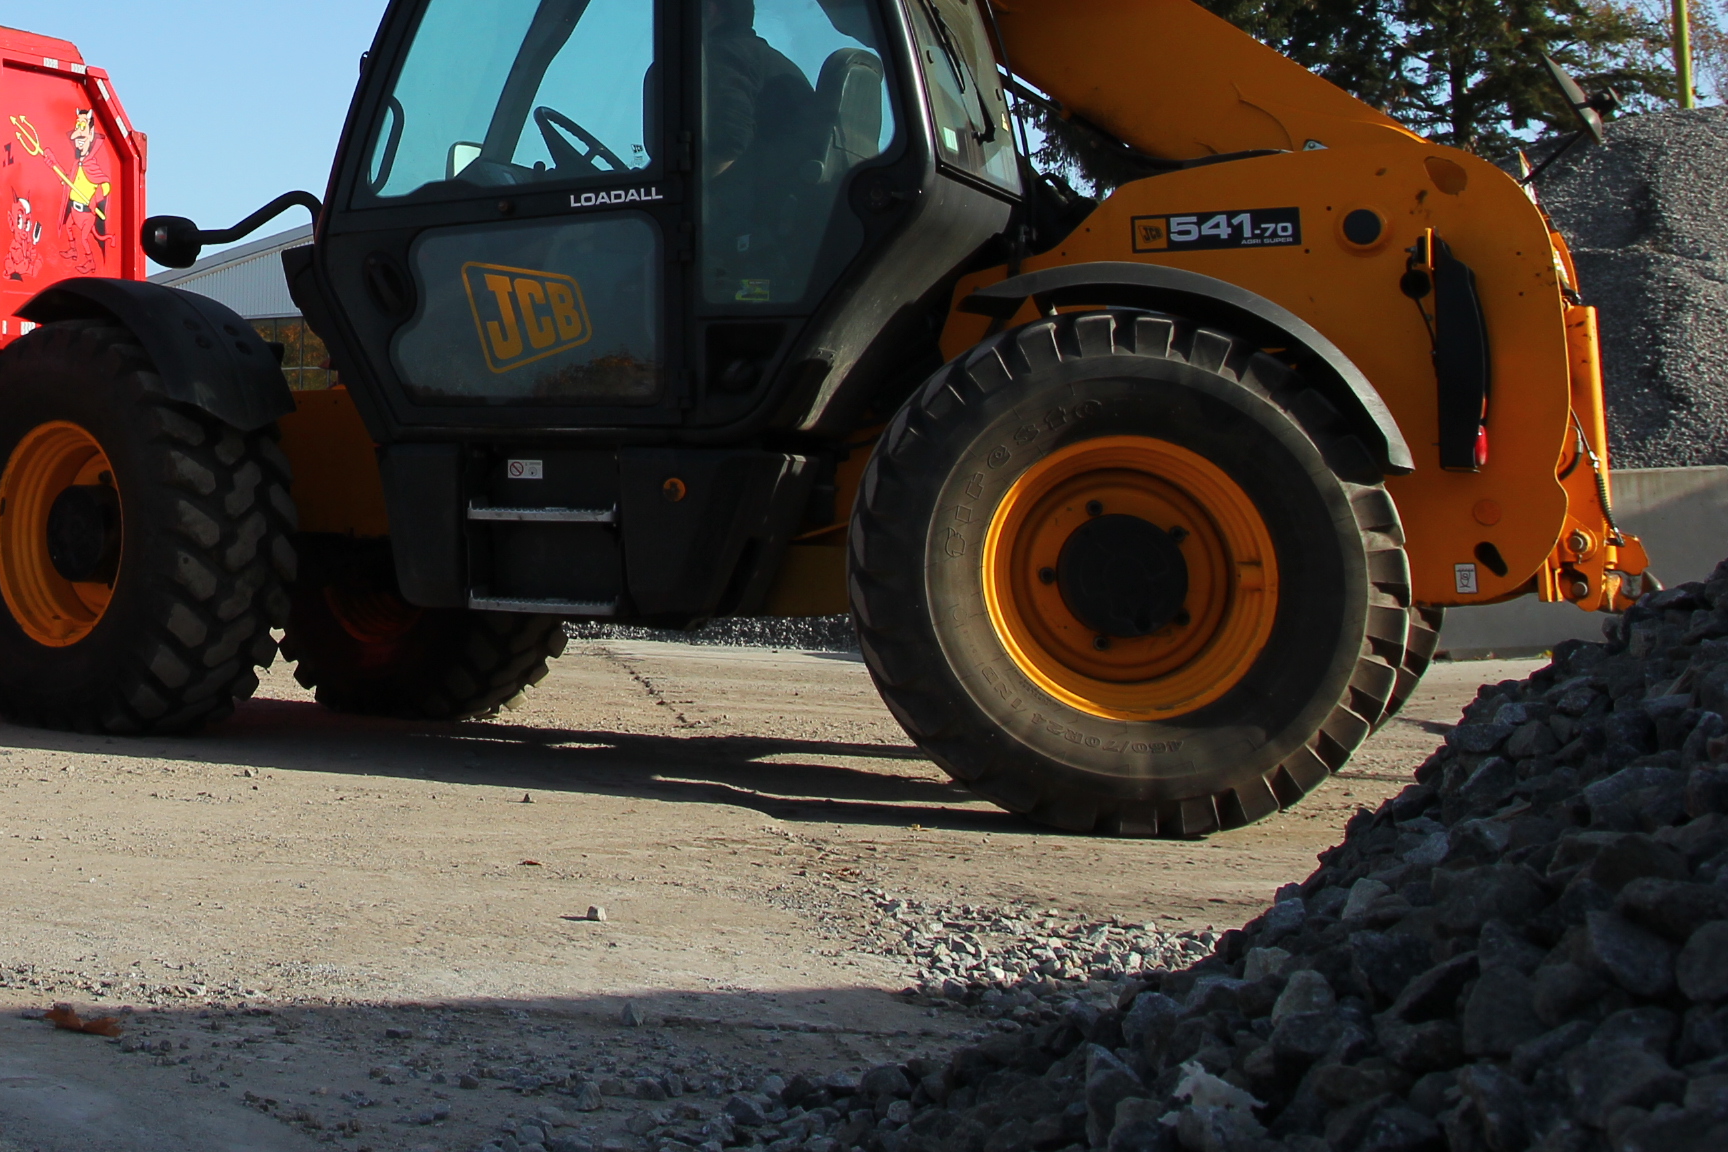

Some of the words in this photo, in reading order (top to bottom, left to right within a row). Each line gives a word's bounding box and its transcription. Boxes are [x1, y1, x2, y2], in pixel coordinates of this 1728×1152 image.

[570, 187, 663, 208] LOADALL
[1138, 225, 1163, 243] JCB
[1170, 213, 1292, 242] 541-70
[1264, 236, 1293, 244] SUPER
[484, 273, 582, 360] JCB
